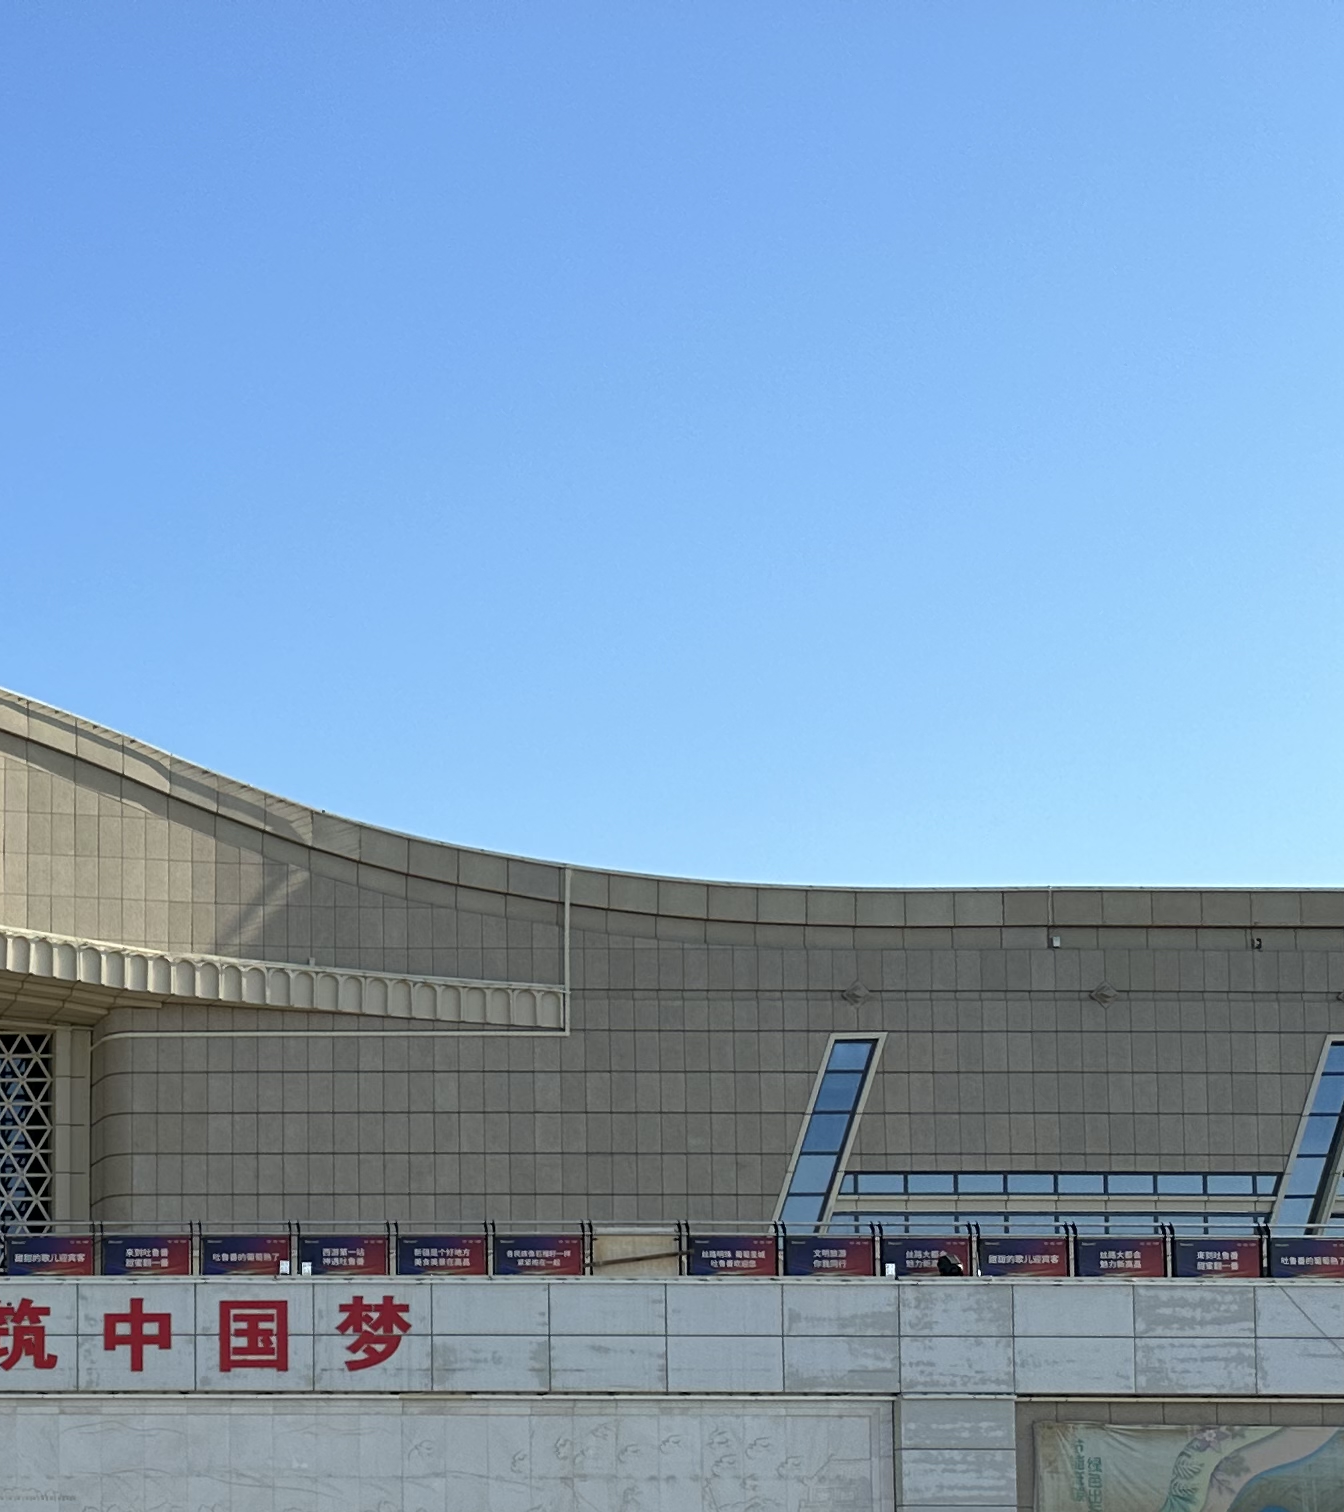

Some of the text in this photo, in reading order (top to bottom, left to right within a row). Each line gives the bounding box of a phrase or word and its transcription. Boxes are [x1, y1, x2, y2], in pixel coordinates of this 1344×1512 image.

[212, 1252, 280, 1262] 吐鲁番的葡萄熟了
